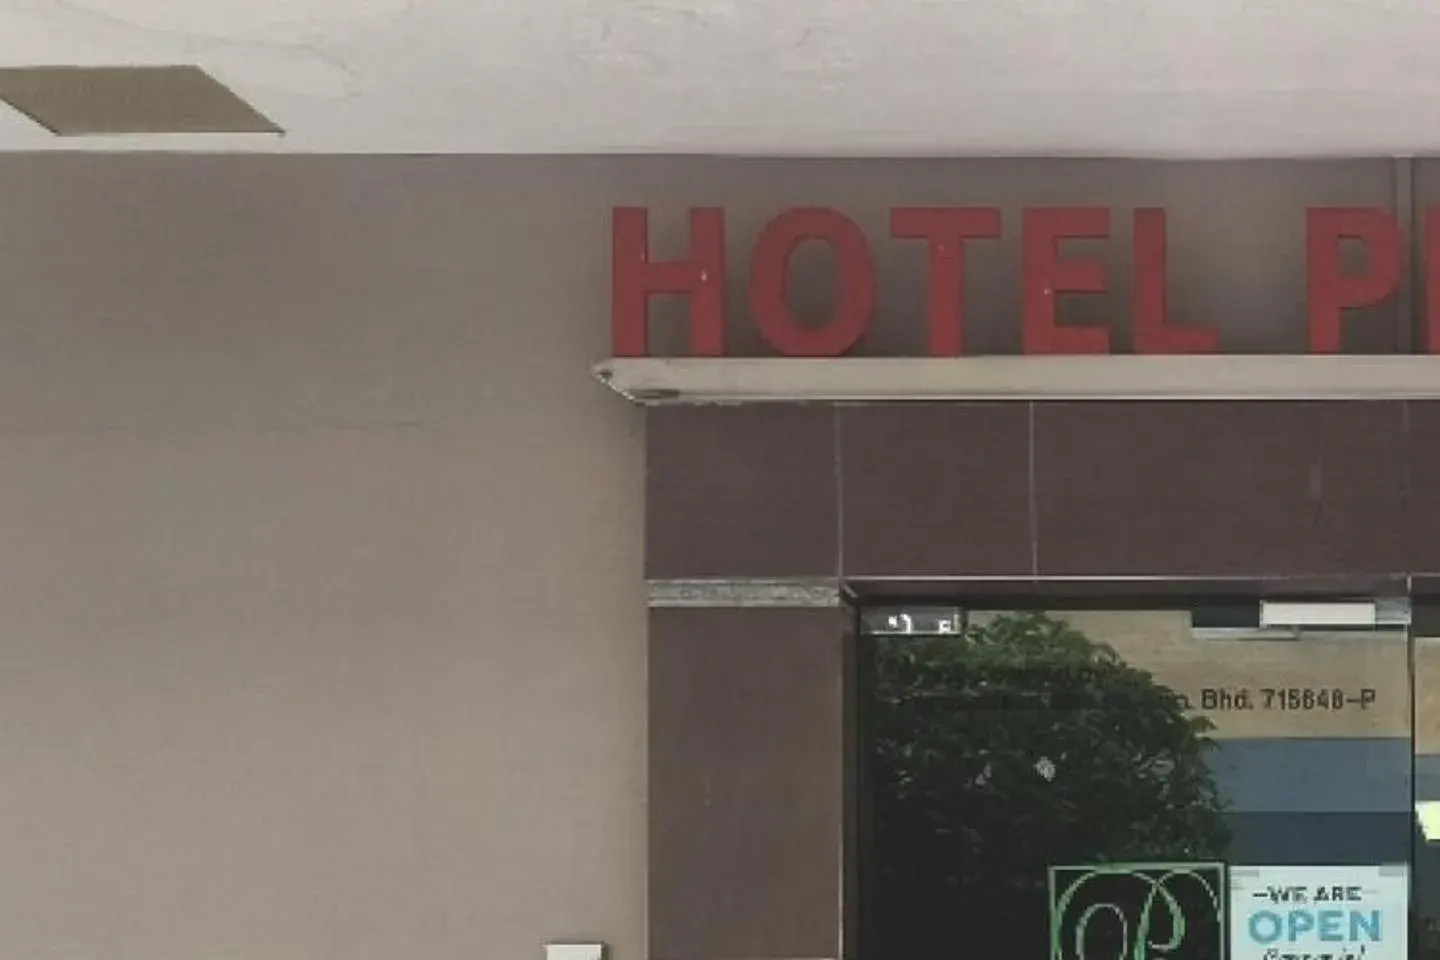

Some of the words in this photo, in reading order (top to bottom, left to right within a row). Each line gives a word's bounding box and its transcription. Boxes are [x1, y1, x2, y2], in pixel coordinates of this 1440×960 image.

[611, 206, 1220, 357] HOTEL
[1313, 886, 1362, 902] ARE
[1248, 909, 1381, 945] OPEN
